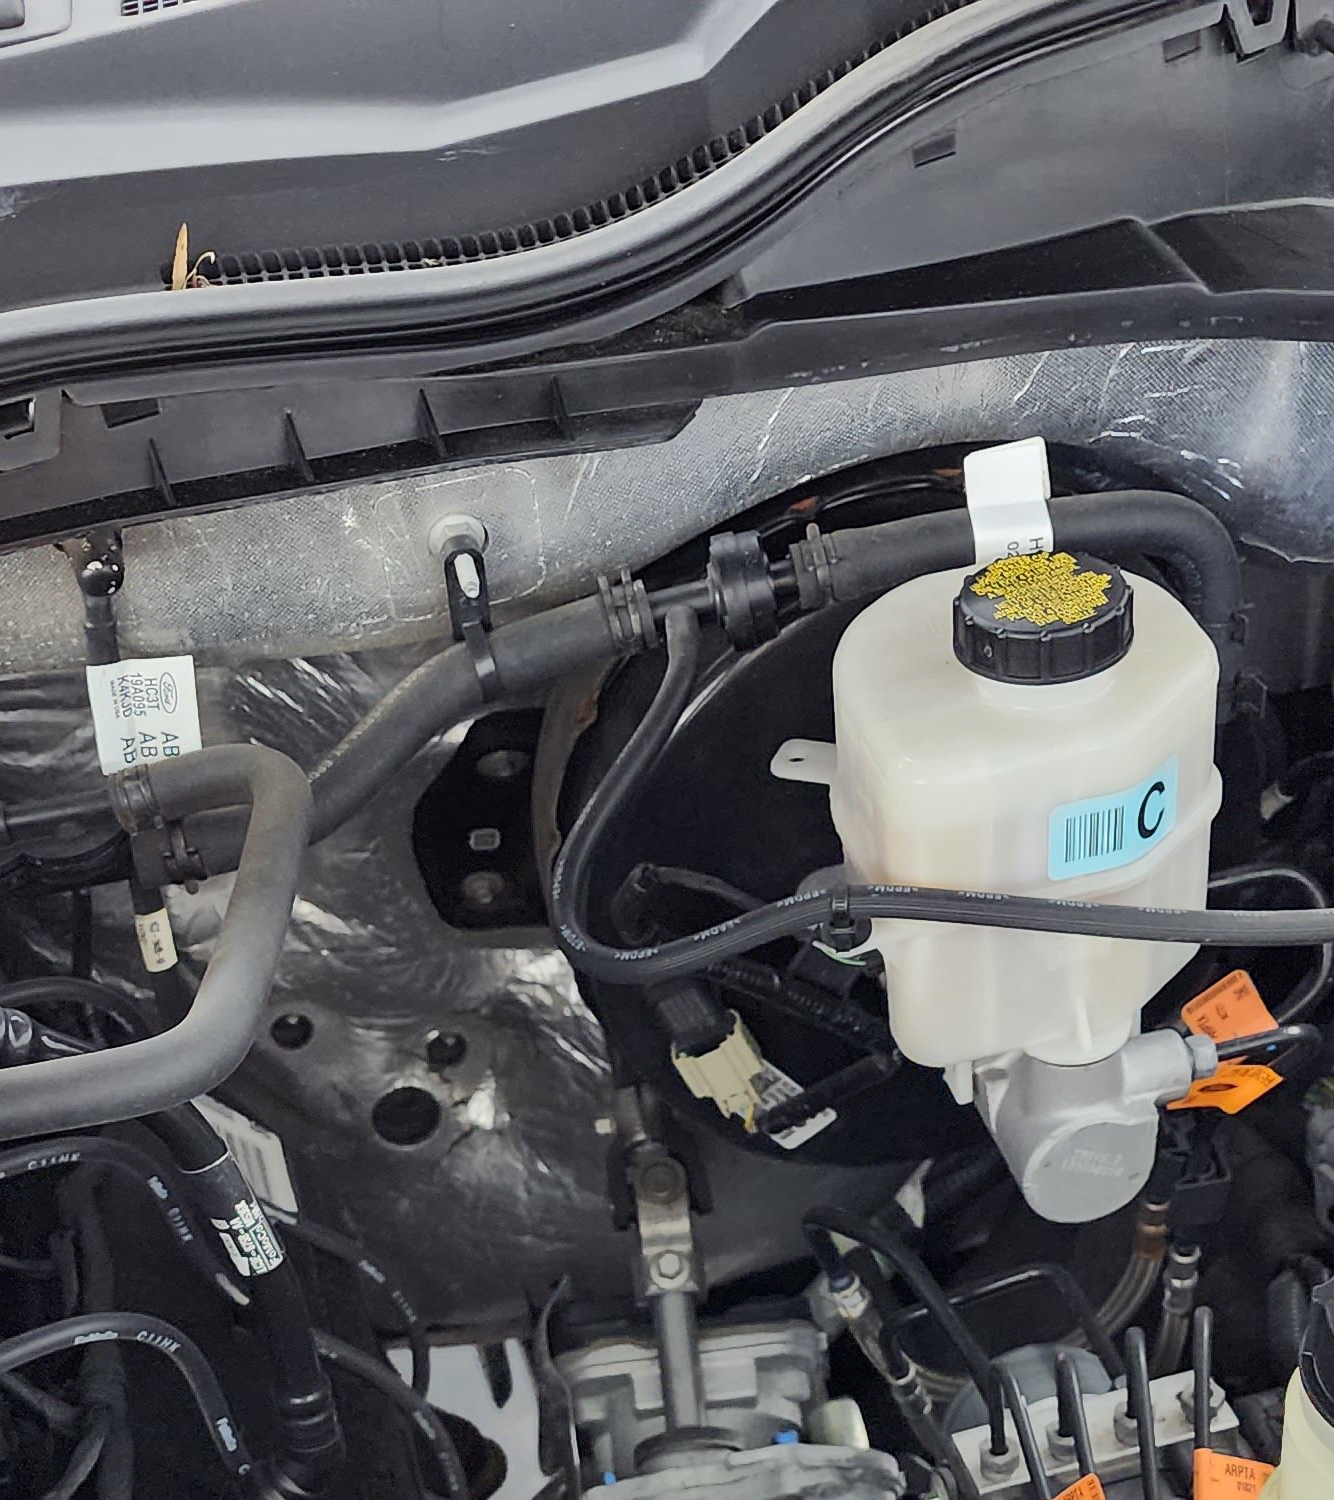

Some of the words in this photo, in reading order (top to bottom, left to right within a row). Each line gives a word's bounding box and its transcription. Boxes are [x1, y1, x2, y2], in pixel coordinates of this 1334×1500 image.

[130, 672, 147, 717] 19A095
[144, 678, 160, 710] HC3T
[121, 737, 137, 764] AB
[139, 732, 158, 758] AB
[161, 732, 180, 758] AB
[1137, 781, 1166, 839] C
